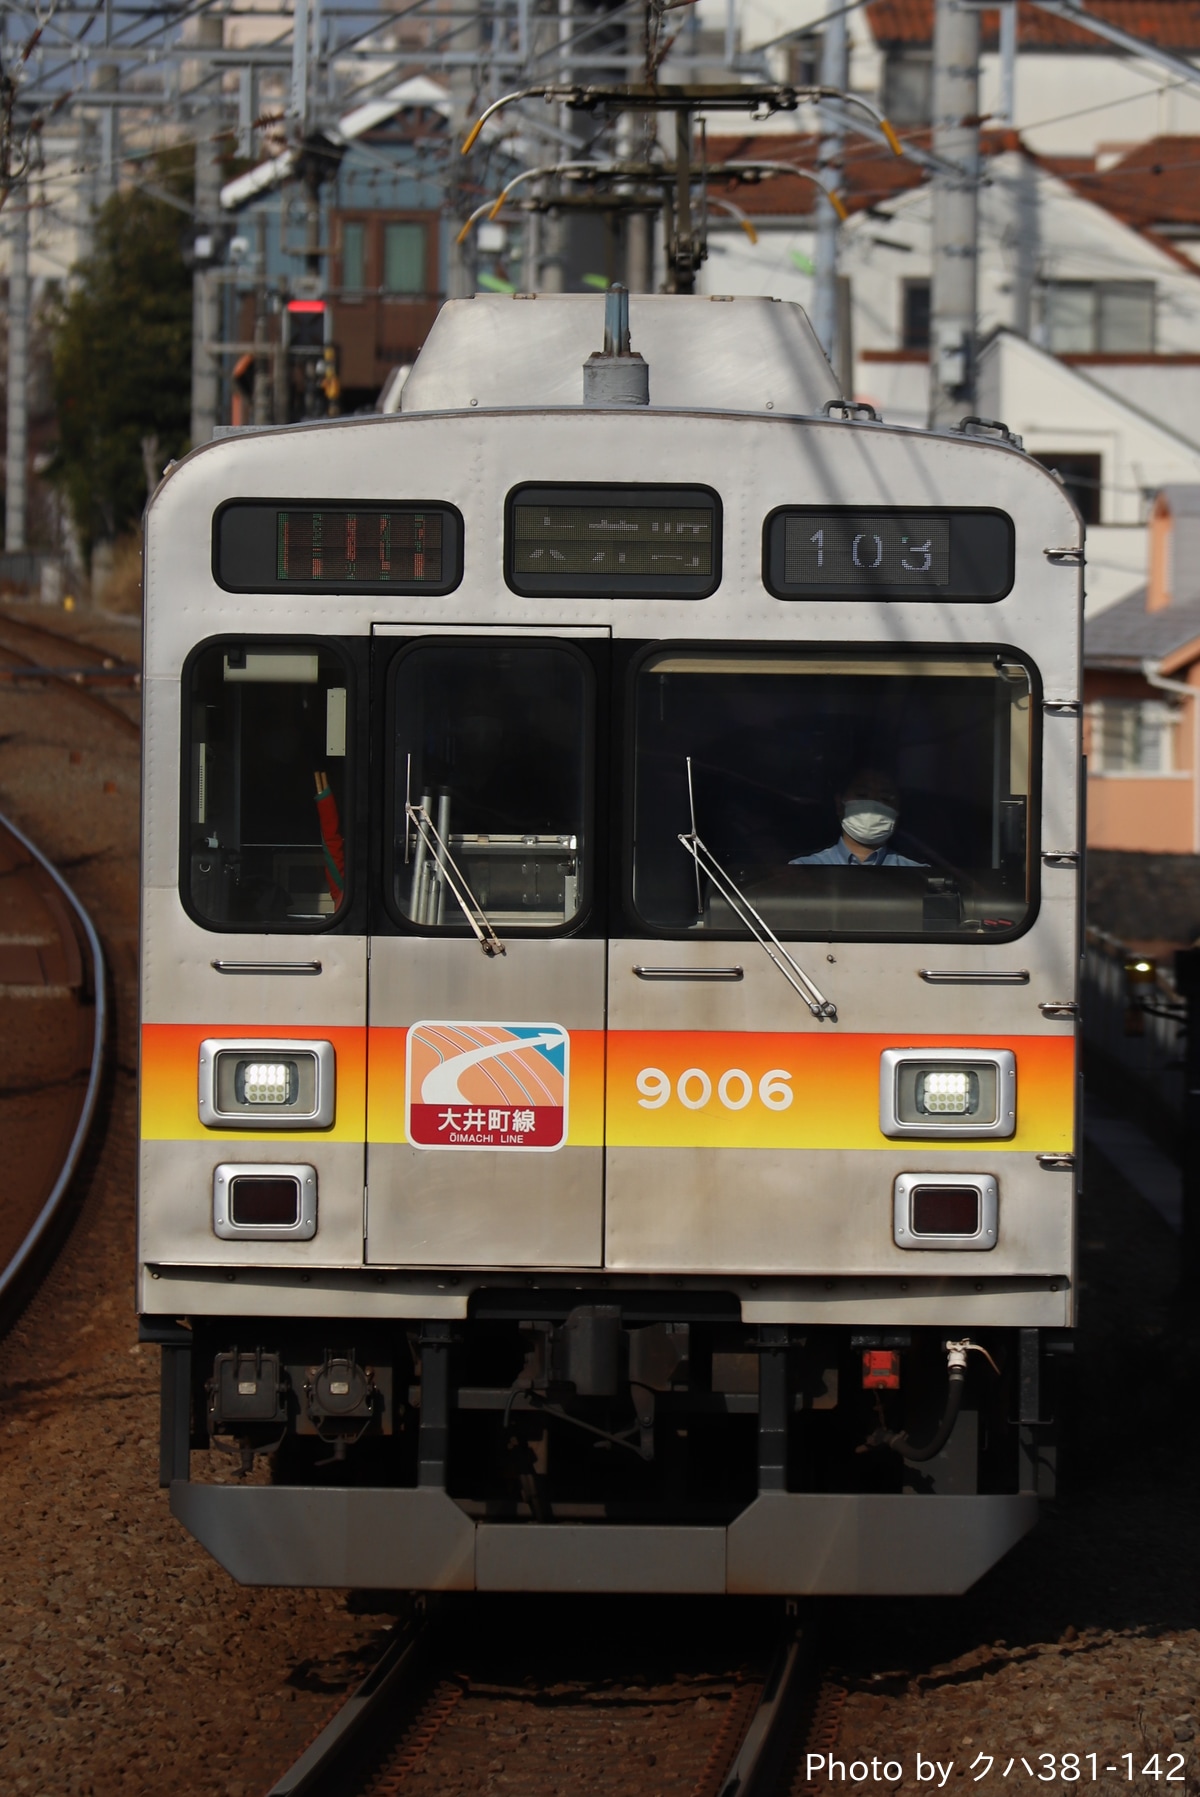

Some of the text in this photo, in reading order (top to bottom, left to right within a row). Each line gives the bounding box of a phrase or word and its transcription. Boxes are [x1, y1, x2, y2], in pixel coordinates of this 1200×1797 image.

[636, 1067, 794, 1111] 9006
[438, 1107, 536, 1133] 大井町線
[500, 1134, 524, 1144] LINE
